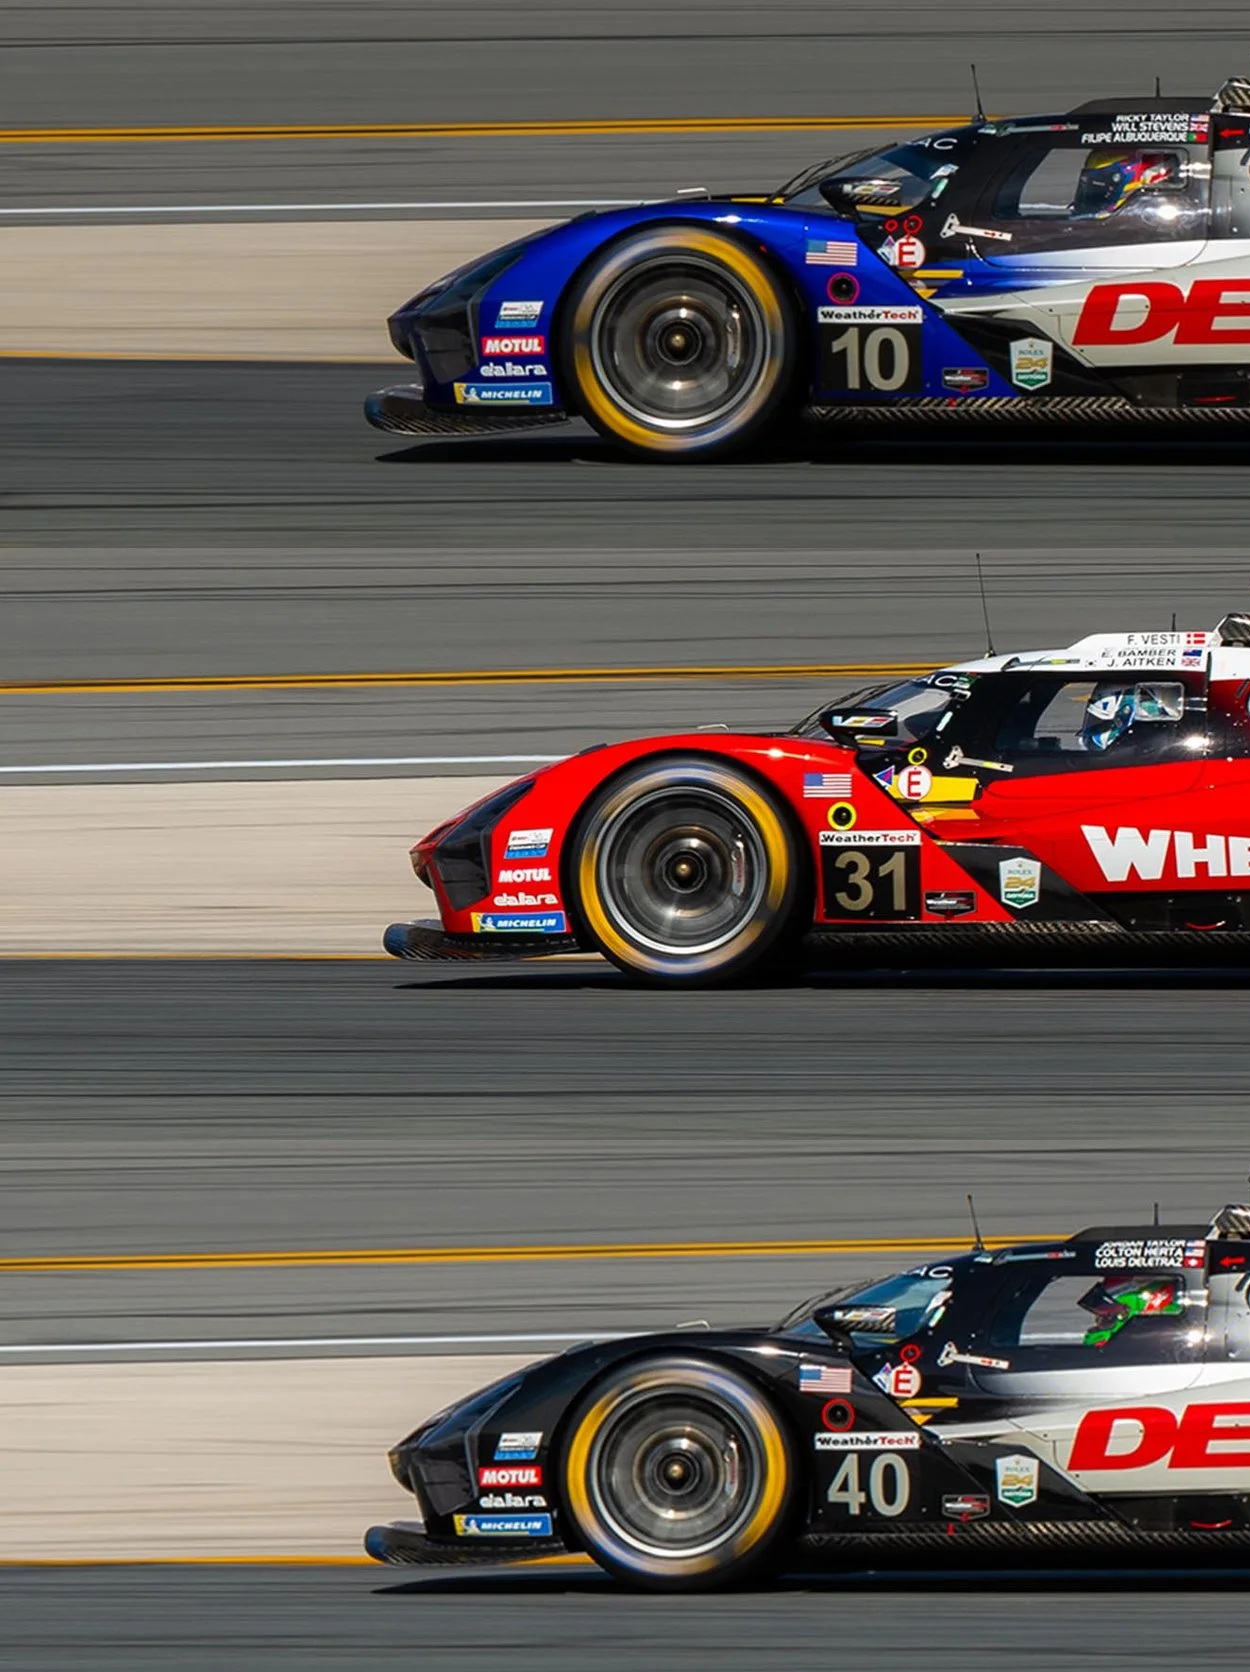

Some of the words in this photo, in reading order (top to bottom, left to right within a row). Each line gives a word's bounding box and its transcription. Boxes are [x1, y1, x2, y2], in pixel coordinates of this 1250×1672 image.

[1149, 112, 1190, 122] TAYLOR
[1111, 122, 1138, 132] WILL
[1139, 121, 1189, 132] STEVENS
[1081, 132, 1112, 144] FILIPE
[820, 309, 919, 320] WeatherTech
[484, 338, 542, 354] MOTUL
[830, 326, 910, 392] 10
[1014, 356, 1048, 370] 24
[479, 361, 548, 378] dallara
[480, 389, 543, 400] MICHELIN
[1126, 634, 1138, 646] F.
[1140, 633, 1181, 646] VESTI
[1117, 648, 1178, 658] BAMBER
[1121, 657, 1177, 667] AITKEN
[820, 833, 916, 844] WeatherTech
[497, 867, 552, 883] MOTUL
[834, 850, 906, 912] 31
[1003, 876, 1037, 889] 24
[493, 891, 559, 907] dallara
[496, 917, 557, 929] MICHELIN
[1095, 1246, 1141, 1258] COLTON
[1143, 1247, 1184, 1258] HERTA
[1095, 1257, 1127, 1268] LOUIS
[1127, 1257, 1184, 1268] DELETRAZ
[816, 1435, 915, 1447] WeatherTech
[480, 1469, 539, 1485] MOTUL
[1000, 1473, 1033, 1487] 24
[827, 1452, 910, 1517] 40
[478, 1492, 547, 1508] dallara
[480, 1520, 543, 1531] MICHELIN
